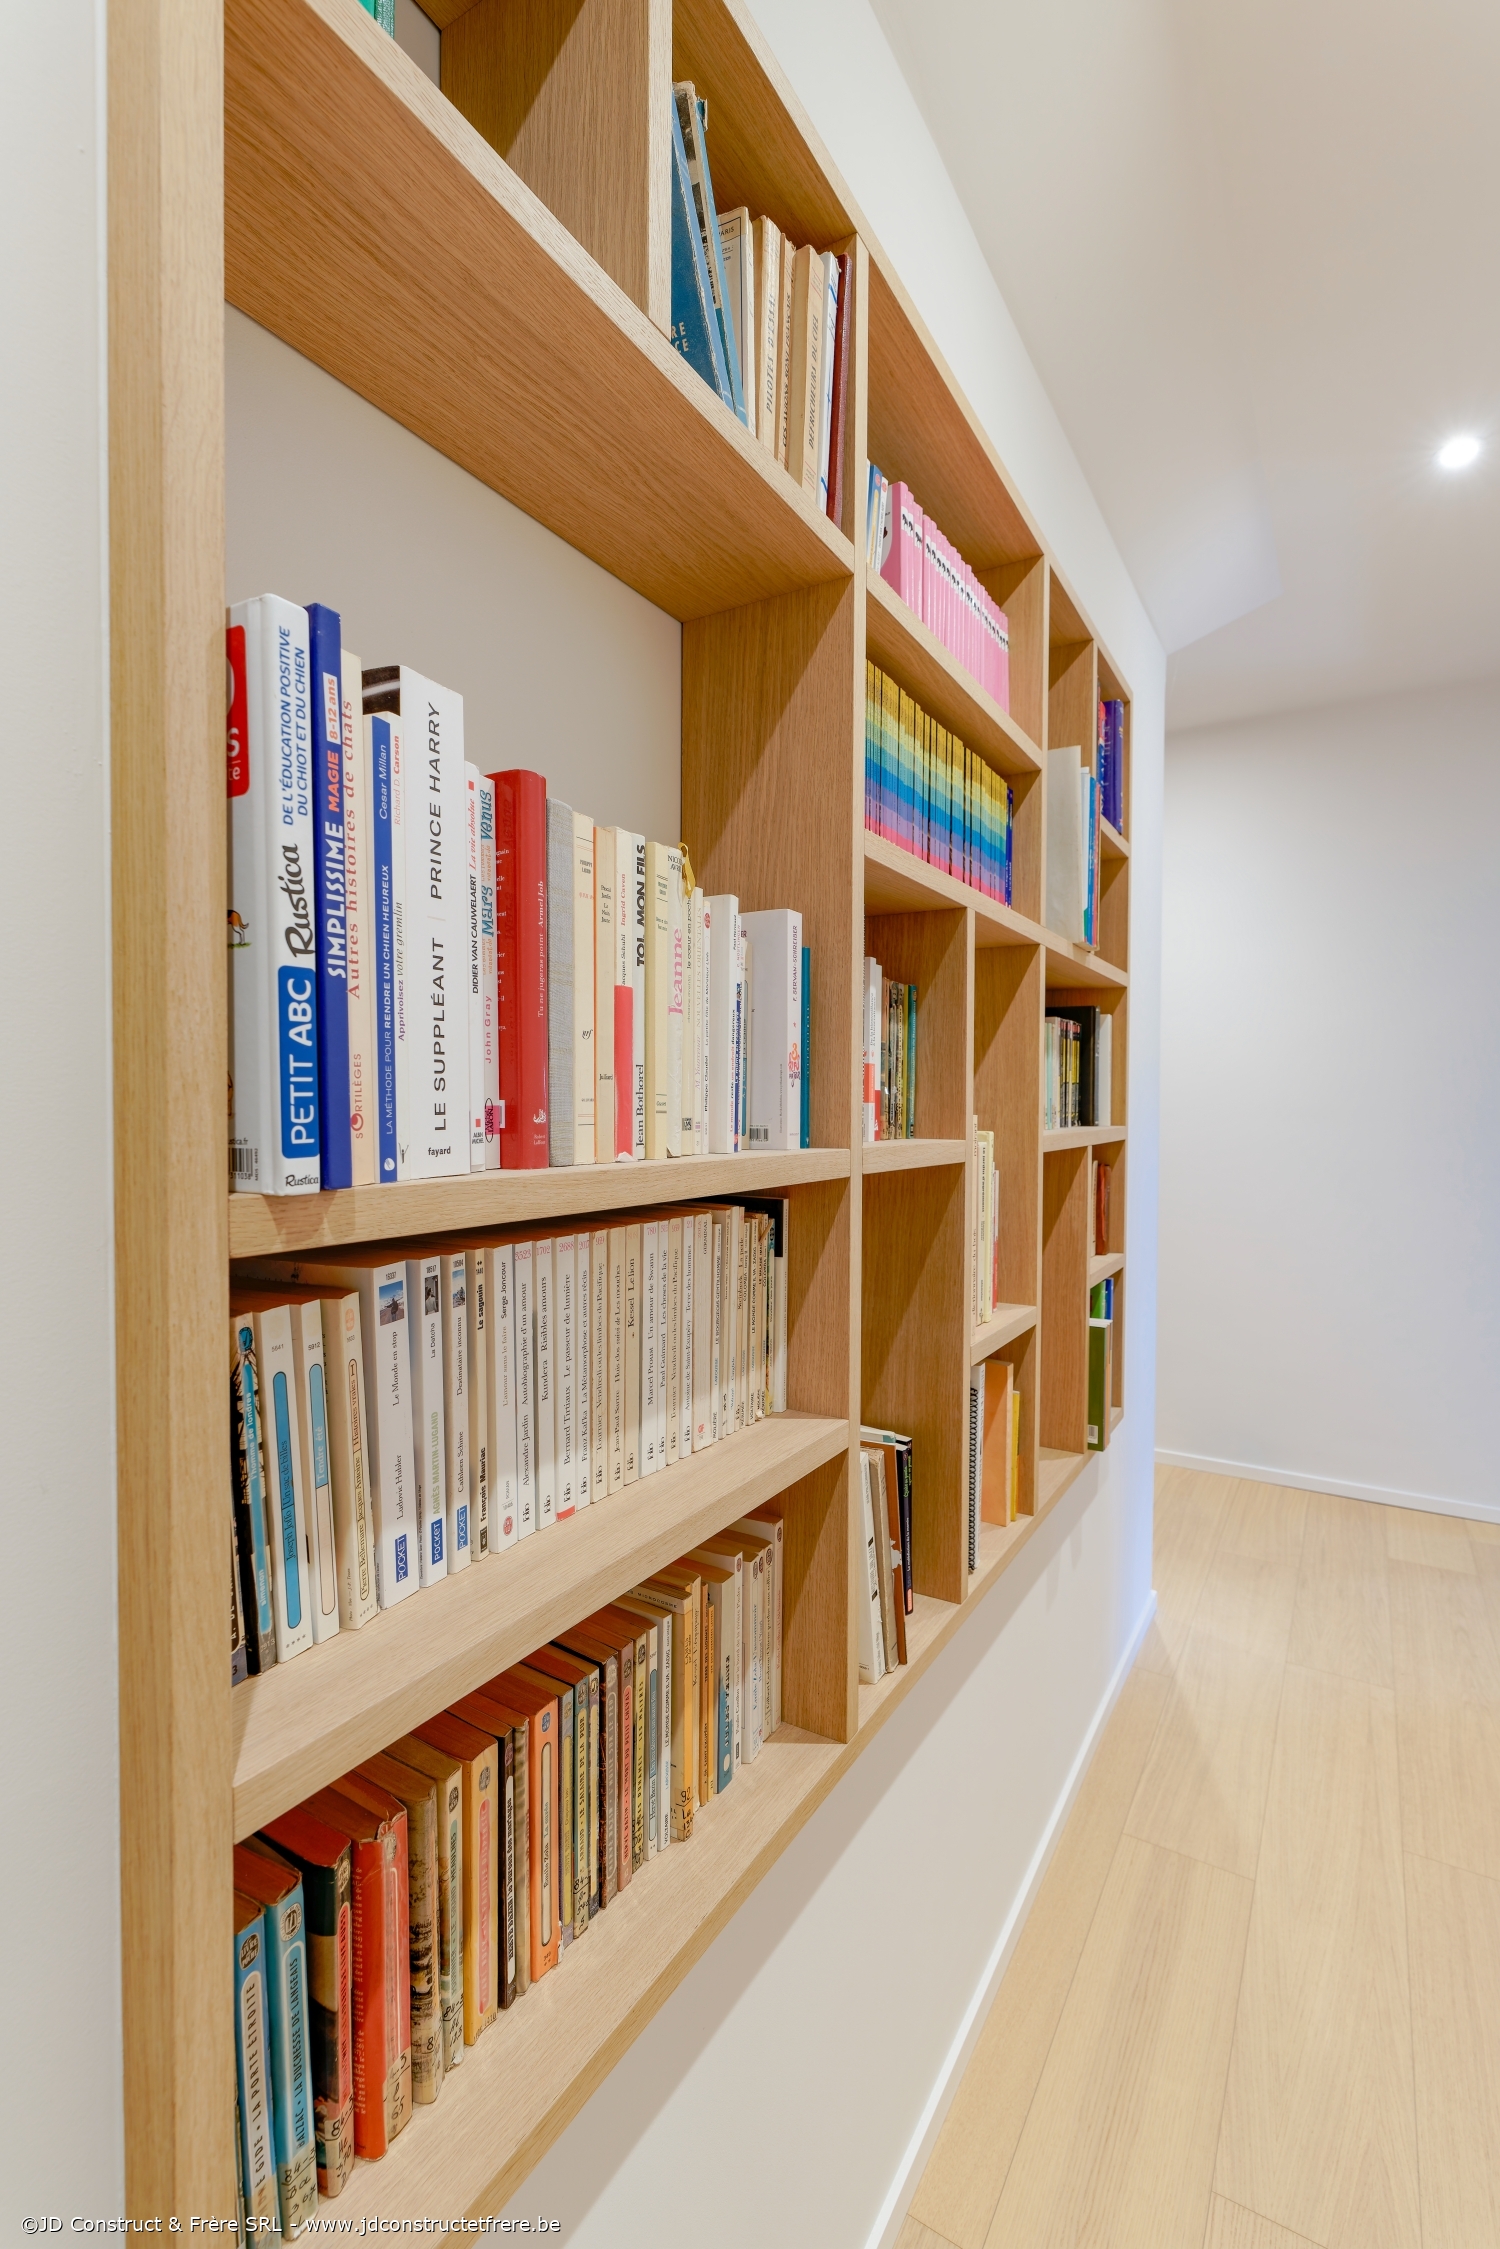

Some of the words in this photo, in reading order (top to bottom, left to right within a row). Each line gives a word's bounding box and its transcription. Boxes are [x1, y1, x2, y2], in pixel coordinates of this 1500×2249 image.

[811, 314, 819, 343] CIEL
[811, 344, 817, 361] DU
[279, 626, 291, 698] POSITIVE
[295, 647, 306, 694] CHIEN
[326, 677, 337, 706] ans
[296, 698, 306, 720] DU
[328, 707, 338, 741] 8-12
[296, 724, 307, 741] ET
[341, 699, 353, 761] chats
[279, 700, 293, 801] L'ÉDUCATION
[379, 744, 388, 780] Millan
[428, 702, 441, 793] HARRY
[296, 746, 307, 791] CHIOT
[327, 750, 339, 813] MAGIE
[343, 771, 355, 798] de
[283, 805, 293, 826] DE
[298, 793, 308, 816] DU
[379, 782, 388, 820] Cesar
[393, 789, 401, 826] Richard
[468, 798, 476, 836] absolue
[343, 809, 357, 913] histoires
[429, 803, 442, 899] PRINCE
[469, 855, 476, 870] La
[637, 844, 645, 875] FILS
[277, 843, 316, 958] Rustica
[325, 821, 347, 978] SIMPLISSIME
[381, 865, 389, 921] HEUREUX
[469, 874, 478, 938] CAUWELAERT
[637, 881, 645, 926] MON
[394, 902, 405, 946] gremlin
[480, 885, 494, 937] Mars
[382, 923, 390, 959] CHIEN
[346, 923, 360, 999] Autres
[383, 963, 390, 979] UN
[394, 948, 404, 976] votre
[667, 928, 684, 1015] Jeanne
[287, 977, 313, 1046] ABC
[383, 982, 391, 1028] RENDRE
[397, 980, 406, 1041] Apprivoisez
[430, 937, 446, 1091] SUPPLÉANT
[484, 996, 493, 1027] Gray
[384, 1032, 392, 1062] POUR
[484, 1032, 492, 1063] John
[289, 1054, 315, 1144] PETIT
[384, 1065, 393, 1118] MÉTHODE
[636, 1064, 644, 1116] Bothorel
[385, 1120, 393, 1134] LA
[434, 1102, 446, 1131] LE
[636, 1120, 644, 1147] Jean
[427, 1146, 451, 1157] fayard
[284, 1173, 319, 1188] Rustica
[477, 1284, 485, 1318] sagouin
[627, 1278, 635, 1291] Le
[648, 1282, 654, 1294] de
[477, 1319, 484, 1330] Le
[564, 1312, 570, 1324] de
[648, 1325, 654, 1339] Un
[521, 1337, 529, 1405] Autobiographie
[563, 1365, 570, 1378] Le
[246, 1392, 254, 1426] londres
[392, 1394, 400, 1405] Le
[563, 1386, 571, 1424] Tirtiaux
[248, 1427, 255, 1438] de
[522, 1415, 530, 1441] Jardin
[280, 1440, 288, 1462] billes
[431, 1411, 439, 1481] MARTIN-LUGAND
[283, 1463, 289, 1474] de
[317, 1446, 325, 1482] Tendre
[355, 1457, 363, 1488] Antoine
[285, 1491, 291, 1504] Un
[356, 1491, 364, 1520] Jacques
[396, 1486, 404, 1520] Ludovic
[431, 1485, 440, 1514] AGNÈS
[285, 1509, 293, 1528] Joffo
[286, 1530, 295, 1560] Joseph
[358, 1523, 366, 1566] Bellemare
[397, 1534, 405, 1580] POCKET
[289, 1957, 299, 2011] LANGEAIS
[246, 1982, 258, 2049] ÉTROITE
[291, 2012, 300, 2024] DE
[292, 2026, 303, 2080] DUCHESSE
[249, 2051, 259, 2097] PORTE
[294, 2082, 303, 2097] LA
[251, 2100, 262, 2119] LA
[294, 2108, 306, 2147] BALZAC
[254, 2134, 265, 2170] GIDE
